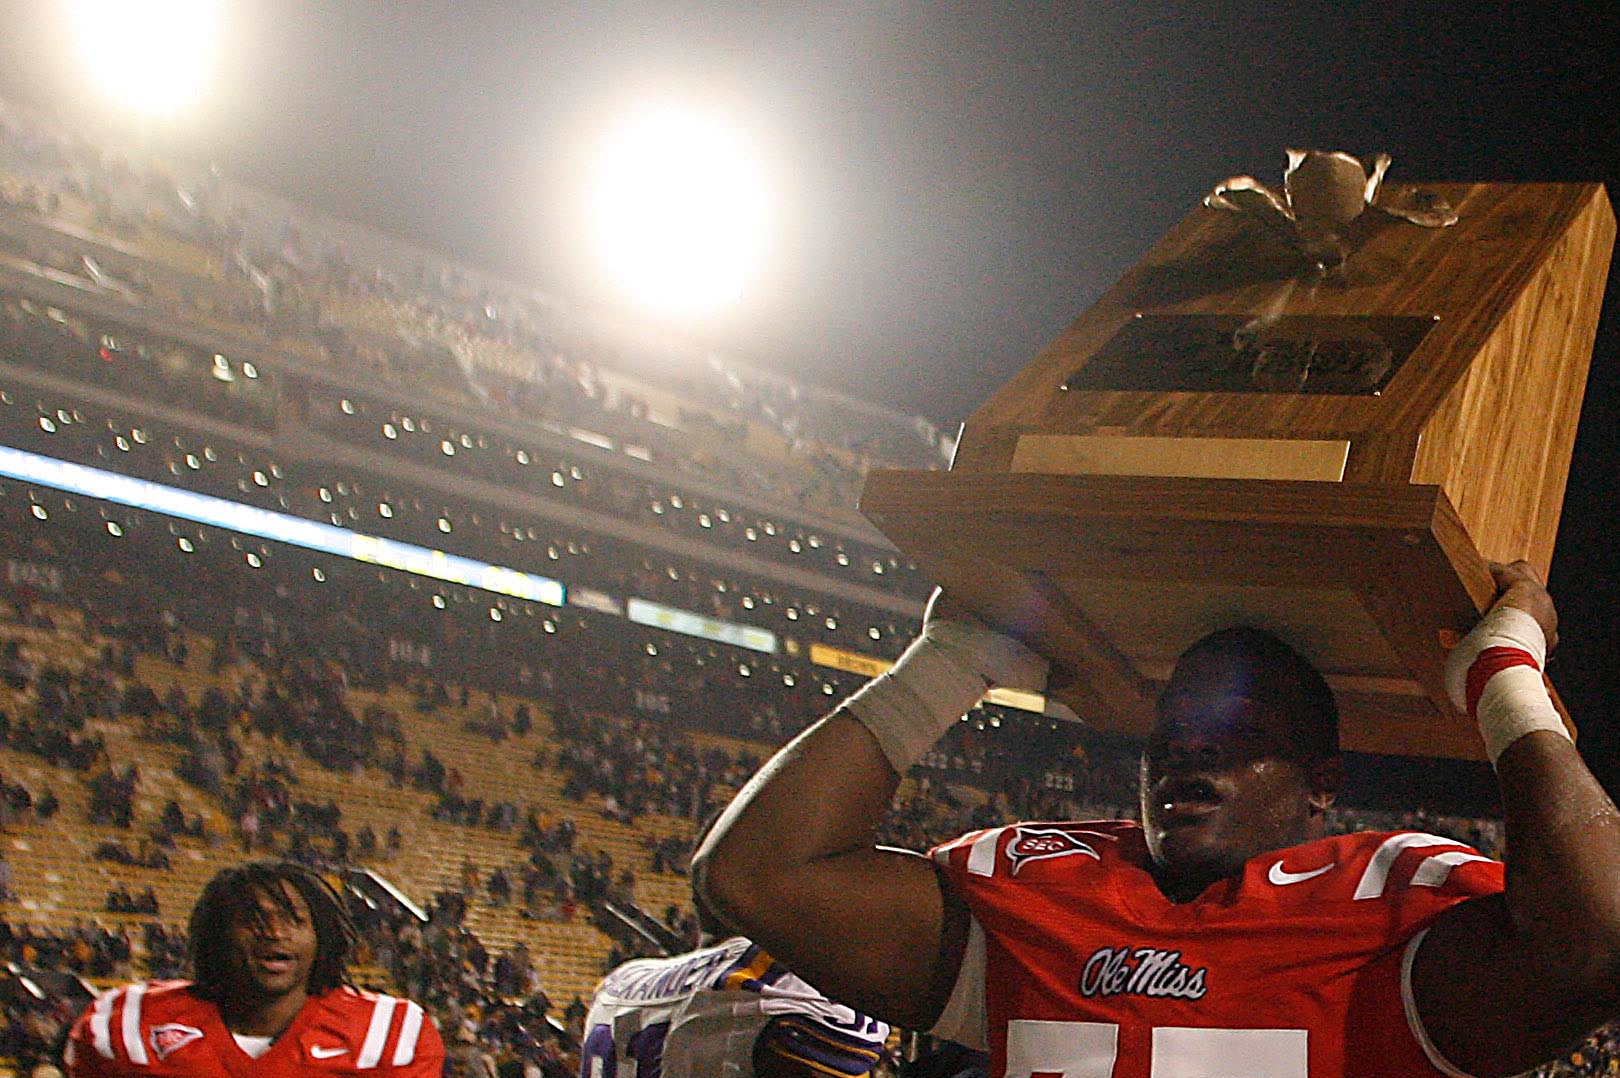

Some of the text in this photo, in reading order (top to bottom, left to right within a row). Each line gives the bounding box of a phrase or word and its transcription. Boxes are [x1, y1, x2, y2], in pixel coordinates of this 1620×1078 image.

[1022, 836, 1065, 851] SEC
[1081, 947, 1207, 999] Ole Miss
